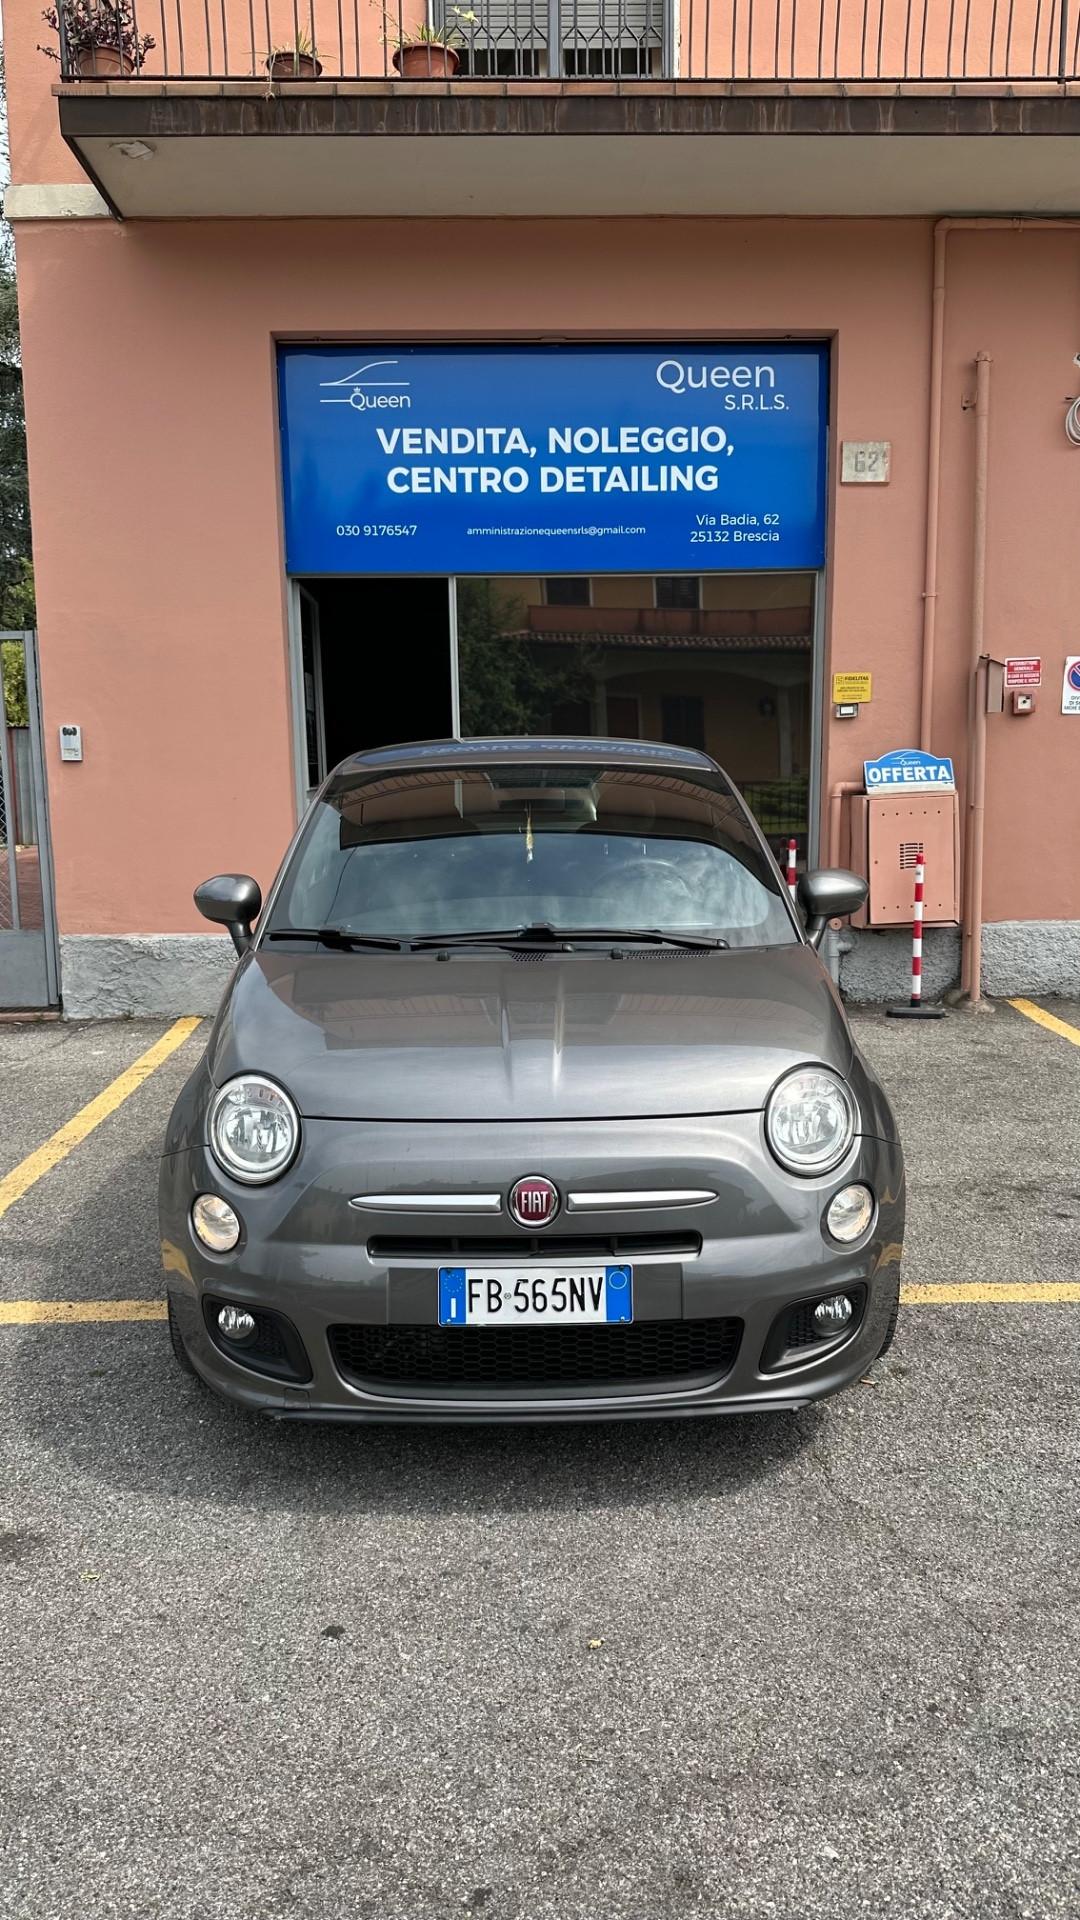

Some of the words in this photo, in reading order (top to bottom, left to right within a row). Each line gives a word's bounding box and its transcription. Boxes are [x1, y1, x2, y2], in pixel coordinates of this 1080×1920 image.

[656, 360, 775, 394] Queen
[350, 393, 411, 411] Queen
[725, 394, 789, 410] S.R.L.S.
[376, 428, 537, 457] VENDITA,
[548, 426, 735, 455] NOLEGGIO,
[387, 467, 529, 494] CENTRO
[540, 465, 719, 493] DETAILING
[696, 514, 716, 526] Via
[720, 513, 760, 527] Badia,
[763, 513, 780, 525] 62
[336, 525, 360, 536] 030
[363, 525, 418, 536] 9176547
[466, 525, 646, 537] amministrazionequeensrls@gmail.com
[690, 531, 730, 542] 25132
[733, 529, 780, 542] Brescia
[868, 766, 951, 783] OFFERTA
[521, 1191, 549, 1213] FIAT
